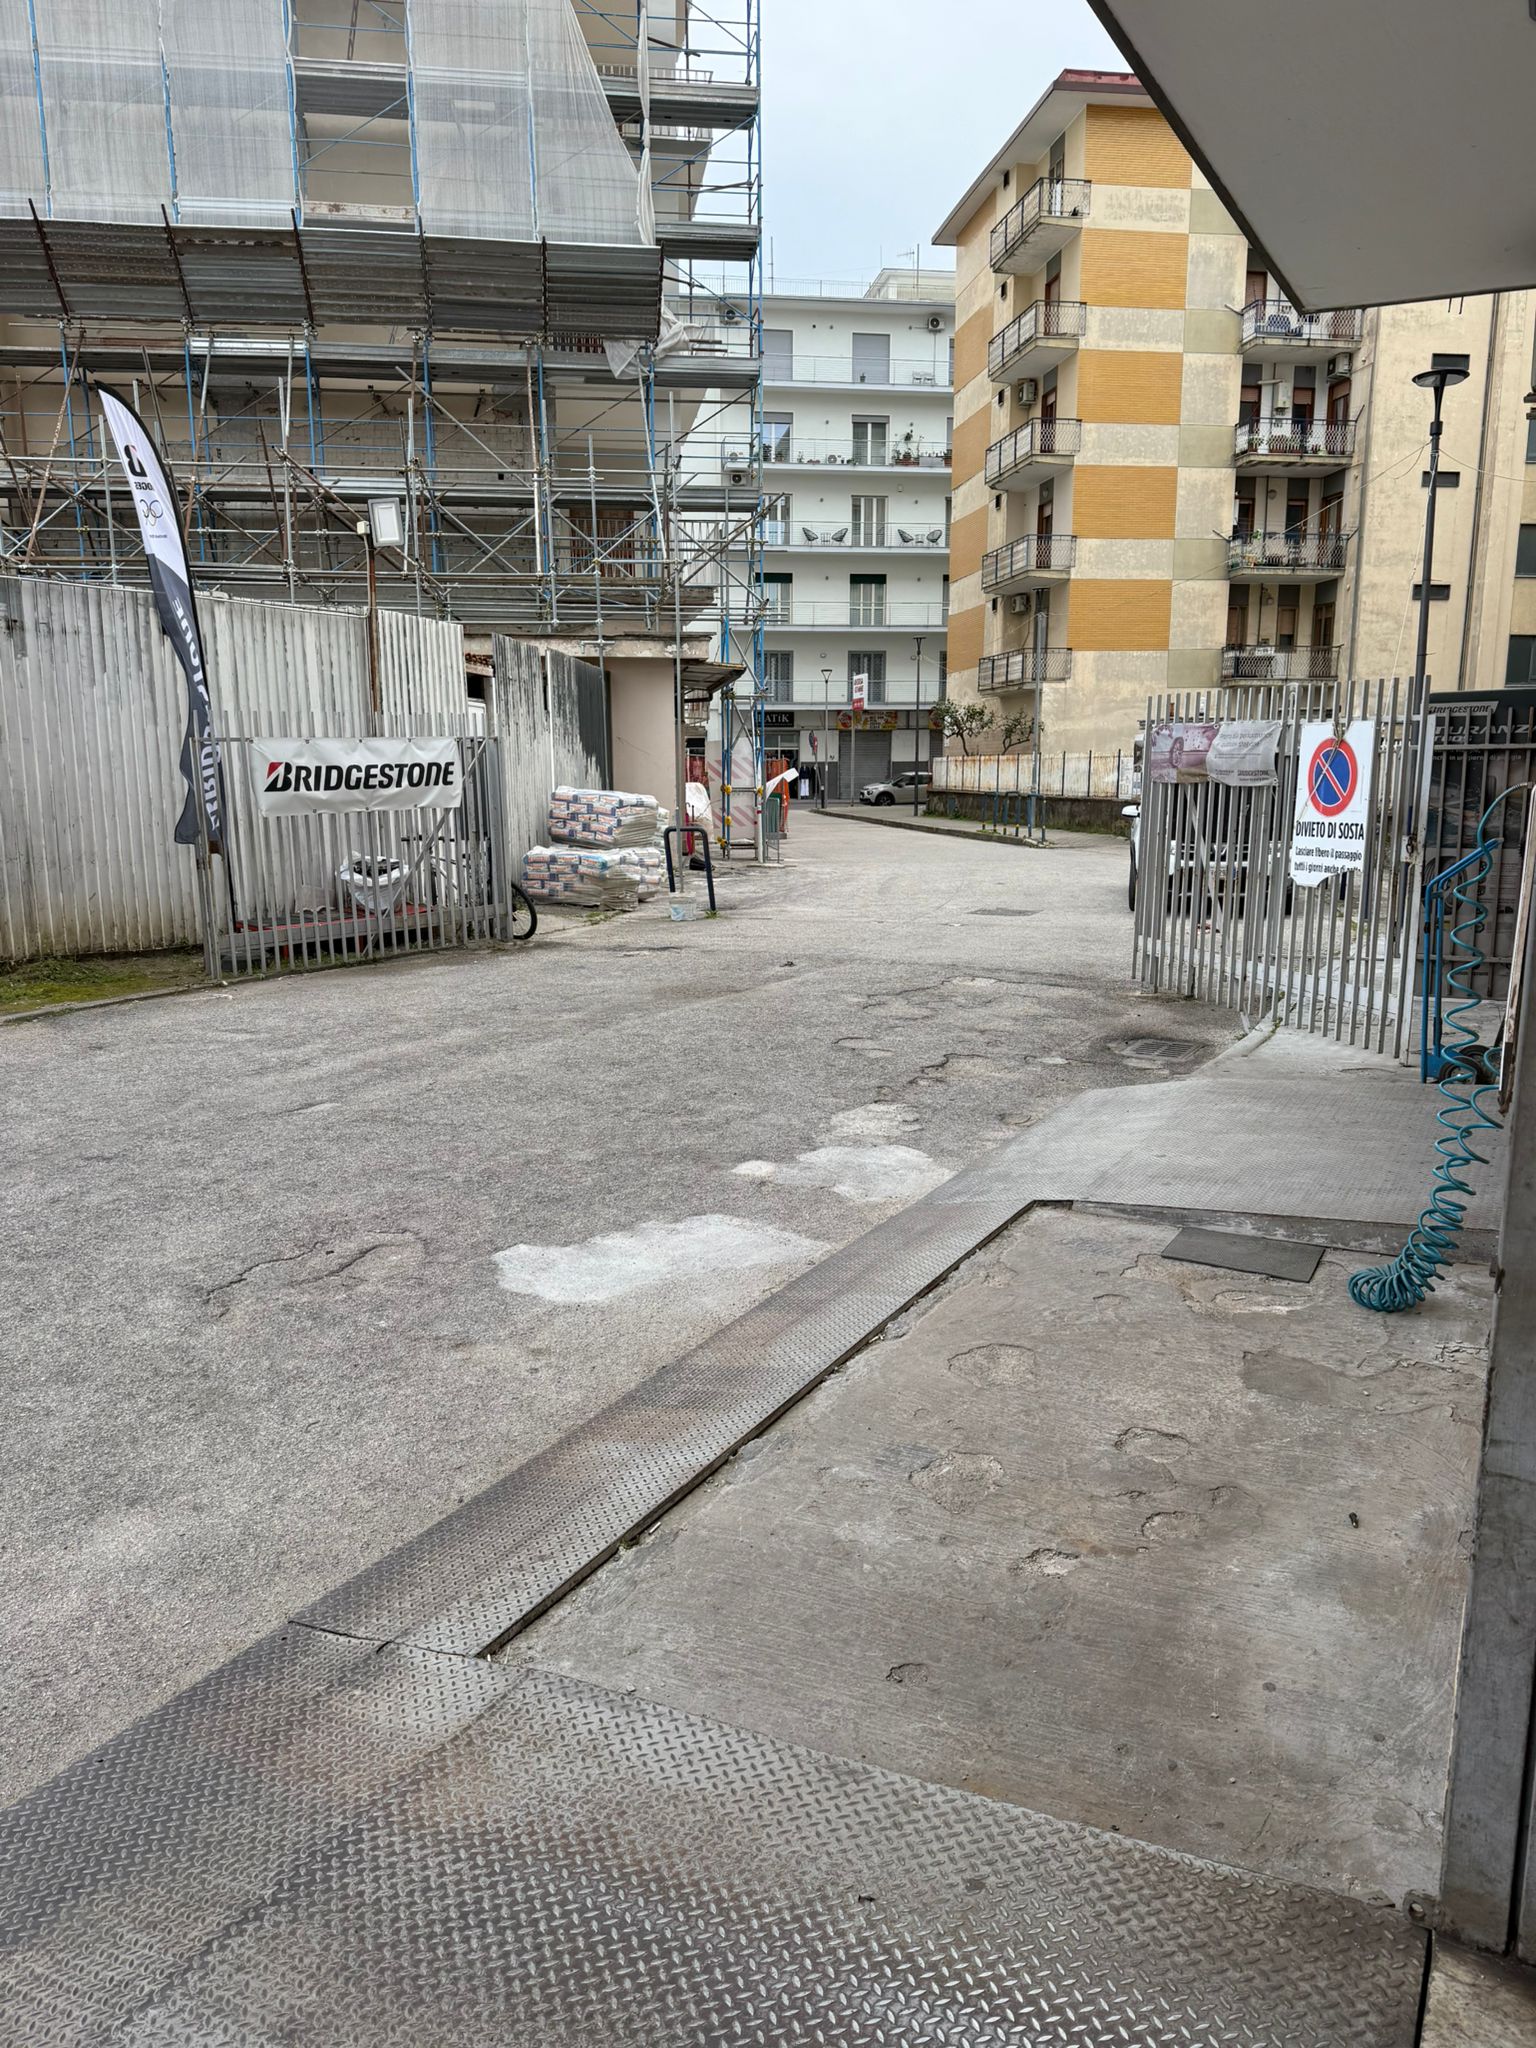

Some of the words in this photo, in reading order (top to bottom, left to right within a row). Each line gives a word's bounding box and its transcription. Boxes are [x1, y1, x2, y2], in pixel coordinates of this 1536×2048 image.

[1435, 725, 1536, 735] TURANZ
[264, 761, 455, 792] BRIDGESTONE
[1295, 821, 1326, 838] DIVIETO
[1327, 822, 1337, 838] DI
[1338, 822, 1364, 840] SOSTA
[1295, 846, 1315, 857] Lasciare
[1335, 849, 1362, 861] passaggio
